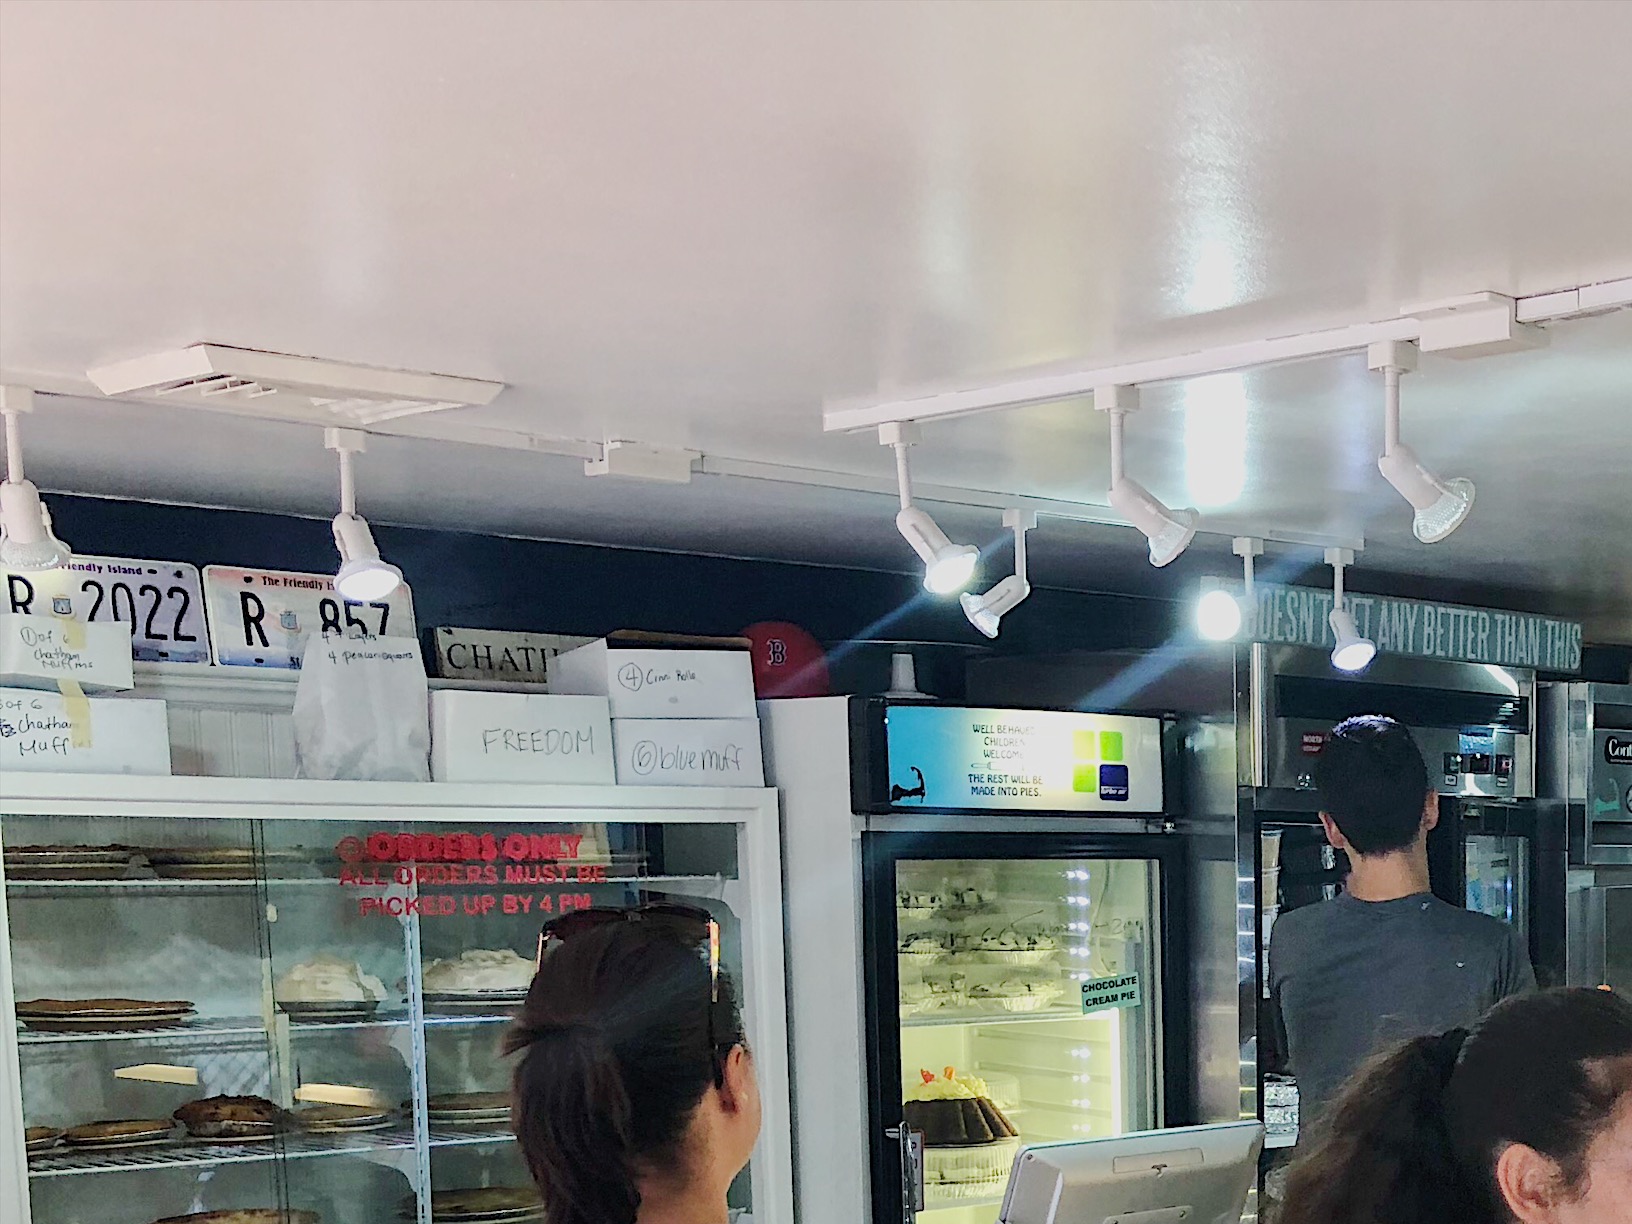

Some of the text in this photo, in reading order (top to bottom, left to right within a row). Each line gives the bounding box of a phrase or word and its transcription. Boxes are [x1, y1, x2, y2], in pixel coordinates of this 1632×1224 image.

[107, 565, 143, 576] Island
[261, 575, 280, 586] The
[283, 577, 323, 591] Friendly
[7, 574, 197, 642] R 2022
[239, 591, 390, 648] R 857
[1378, 599, 1420, 653] ANY
[1423, 605, 1491, 660] BETTER
[1494, 614, 1541, 665] THAN
[1545, 619, 1583, 670] THIS
[766, 638, 788, 667] B
[972, 724, 995, 735] WELL
[482, 726, 594, 756] FREEDOM
[967, 773, 1044, 786] THE REST WILL BE
[970, 786, 995, 797] MADE
[997, 786, 1019, 797] INTO
[503, 832, 584, 861] ONLY
[338, 865, 608, 887] ALL ORDERS MUST BE
[359, 892, 593, 917] PICKED UP BY 4 PM
[1081, 974, 1138, 994] CHOCOLATE
[1085, 989, 1136, 1008] CREAM PIE
